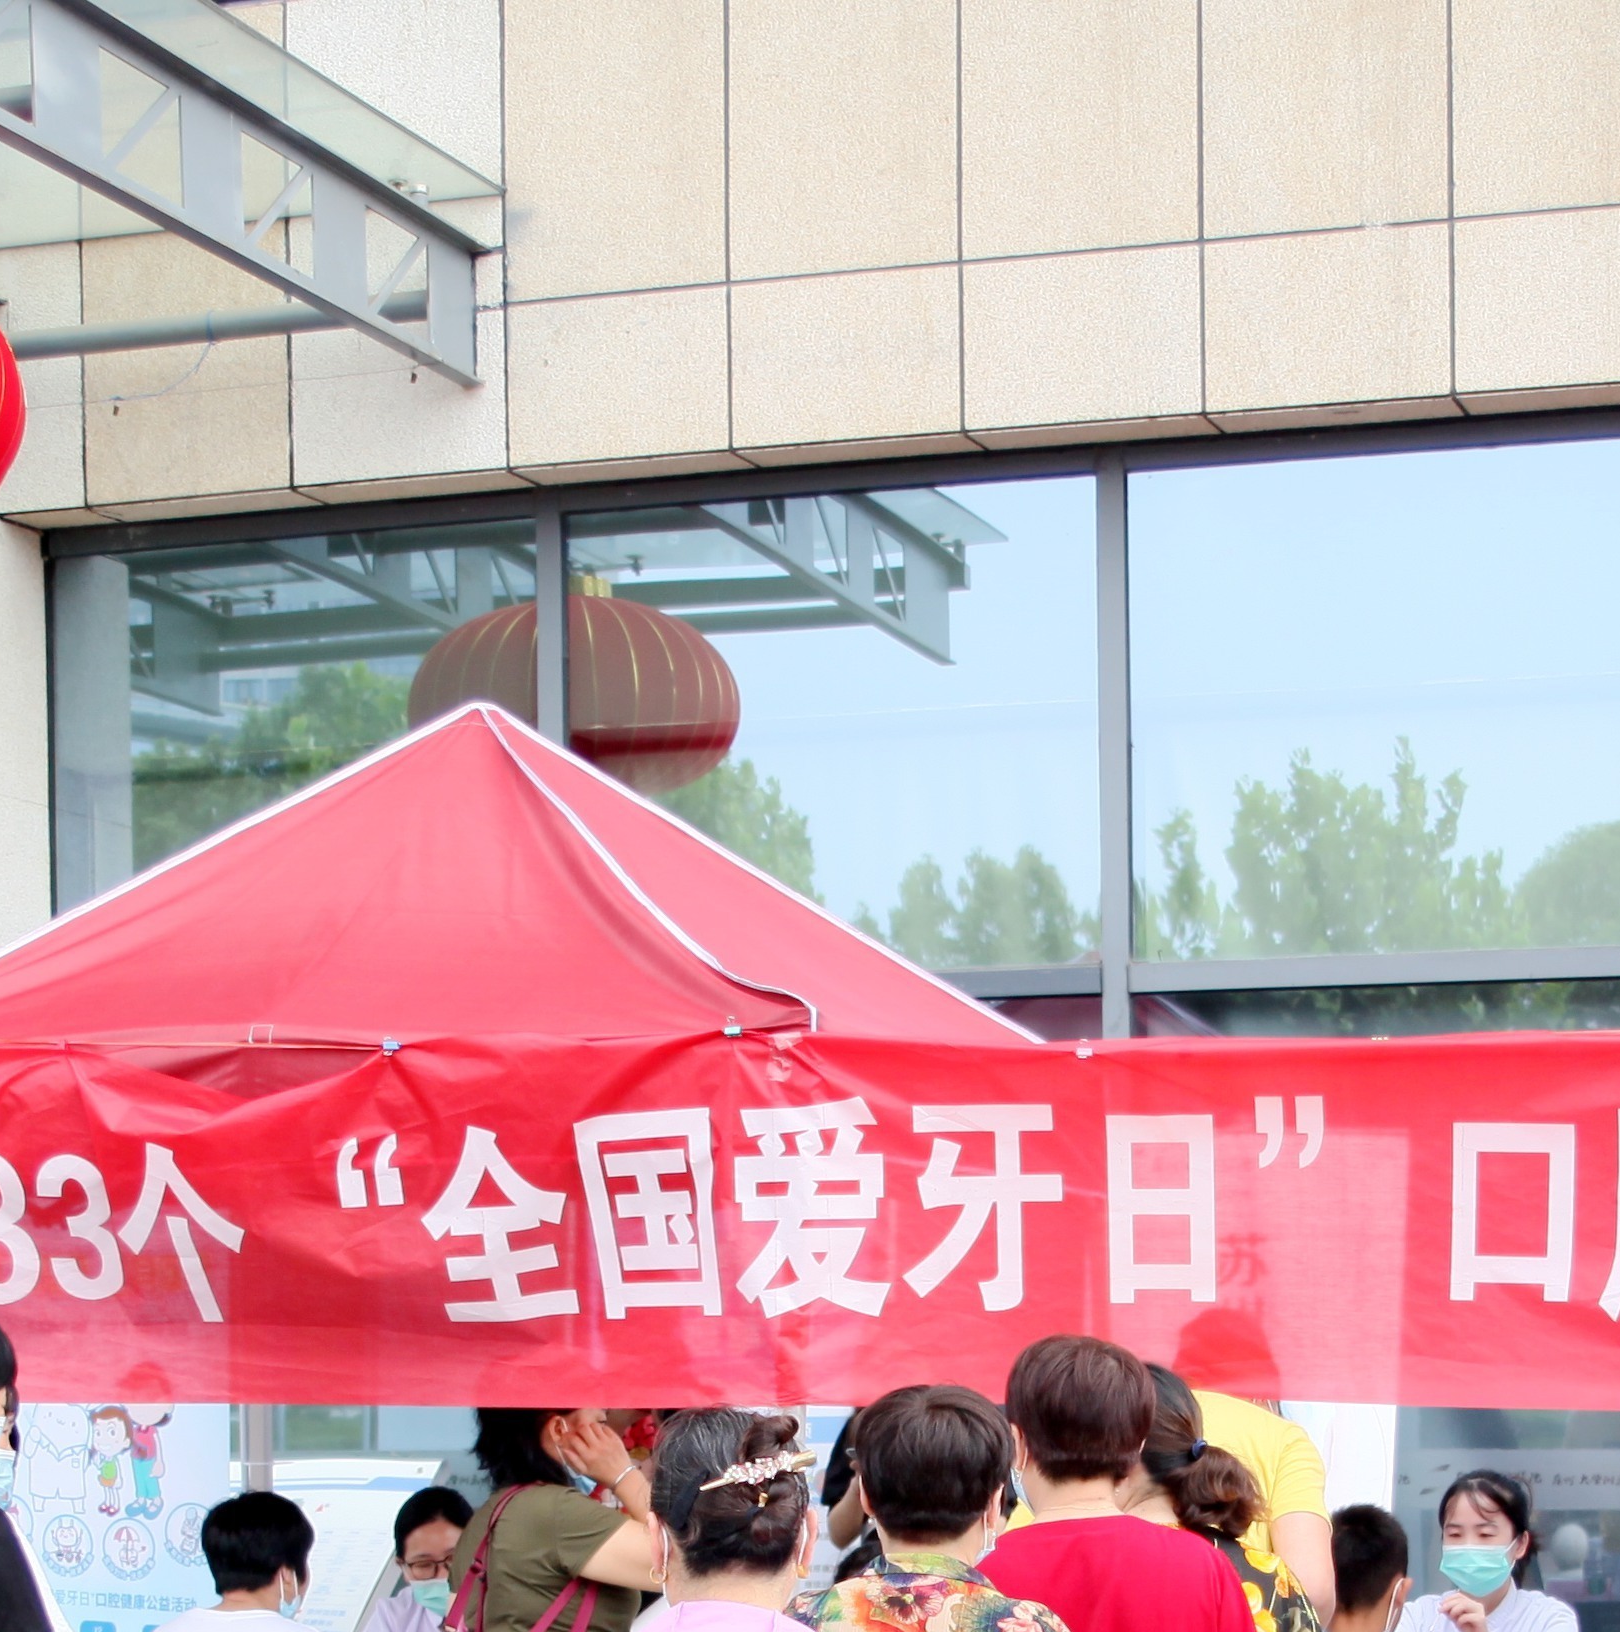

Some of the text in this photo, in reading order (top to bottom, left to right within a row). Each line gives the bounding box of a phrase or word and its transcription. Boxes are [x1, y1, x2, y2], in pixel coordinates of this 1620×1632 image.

[336, 1094, 1326, 1324] “全国爱牙日”
